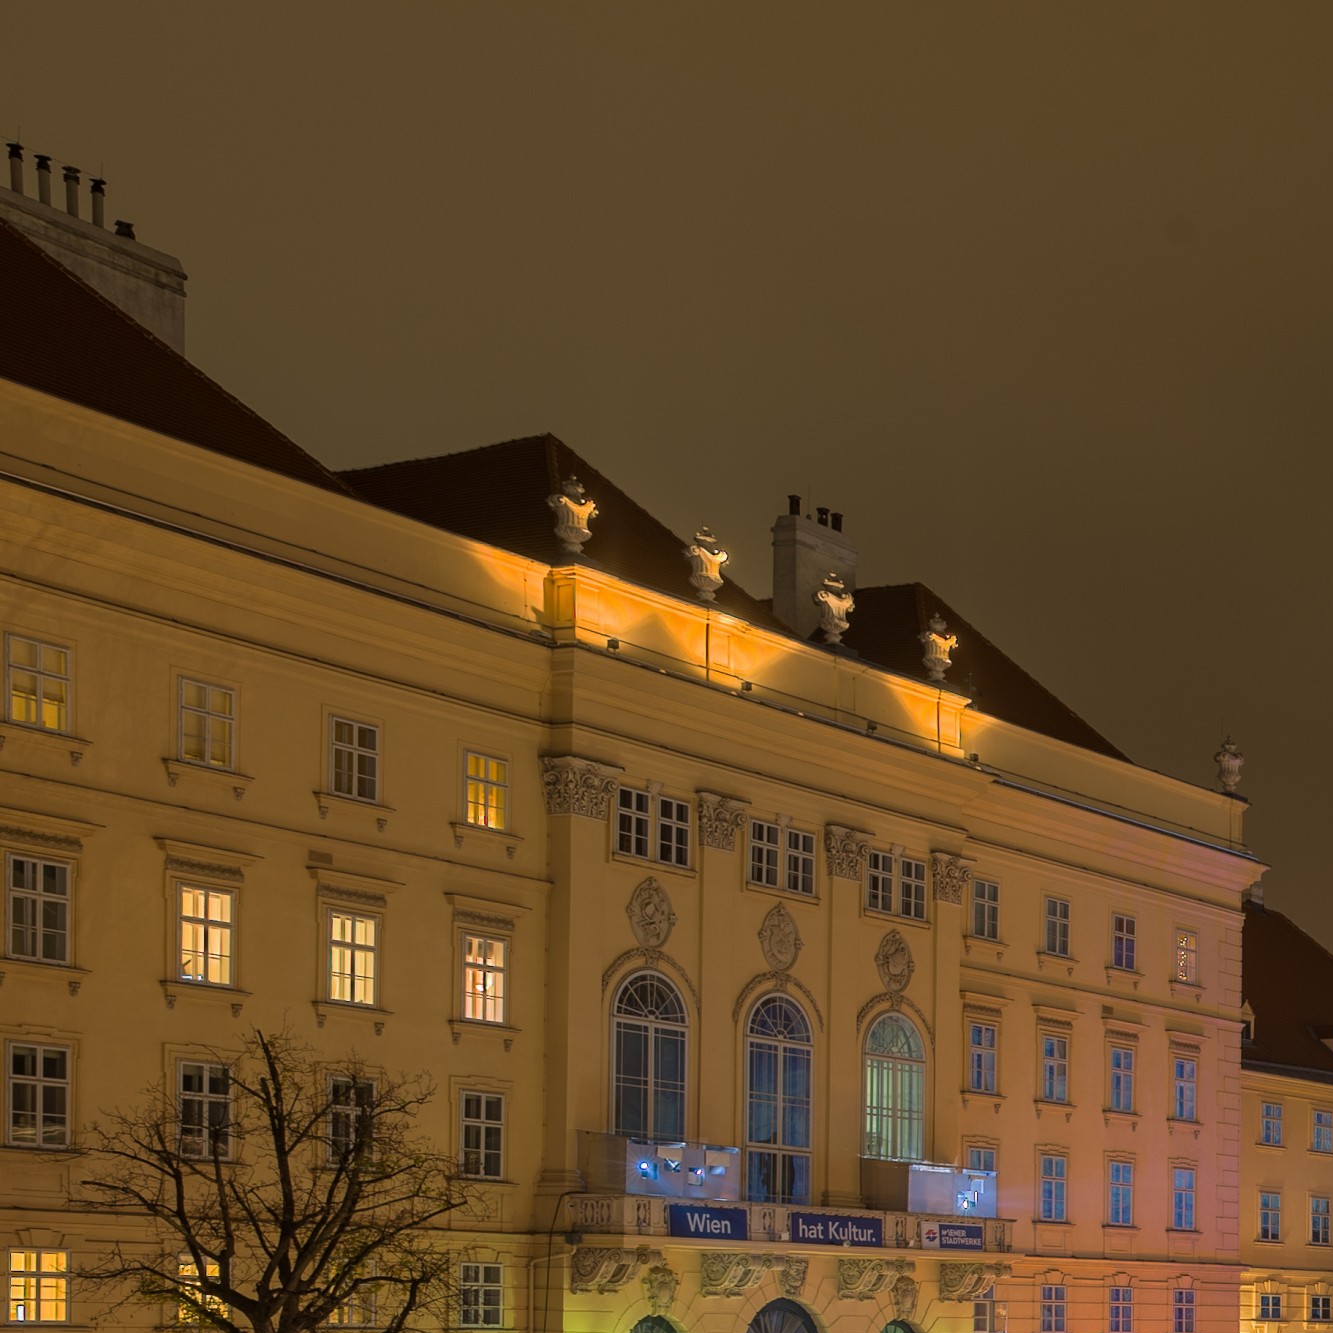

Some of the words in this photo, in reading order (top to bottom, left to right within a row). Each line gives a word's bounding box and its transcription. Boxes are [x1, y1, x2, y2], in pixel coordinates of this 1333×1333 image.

[686, 1212, 731, 1234] Wien
[799, 1218, 824, 1239] hat
[828, 1221, 876, 1242] Kultur.
[941, 1228, 967, 1237] WIENER
[941, 1236, 982, 1246] STADTWERKE
